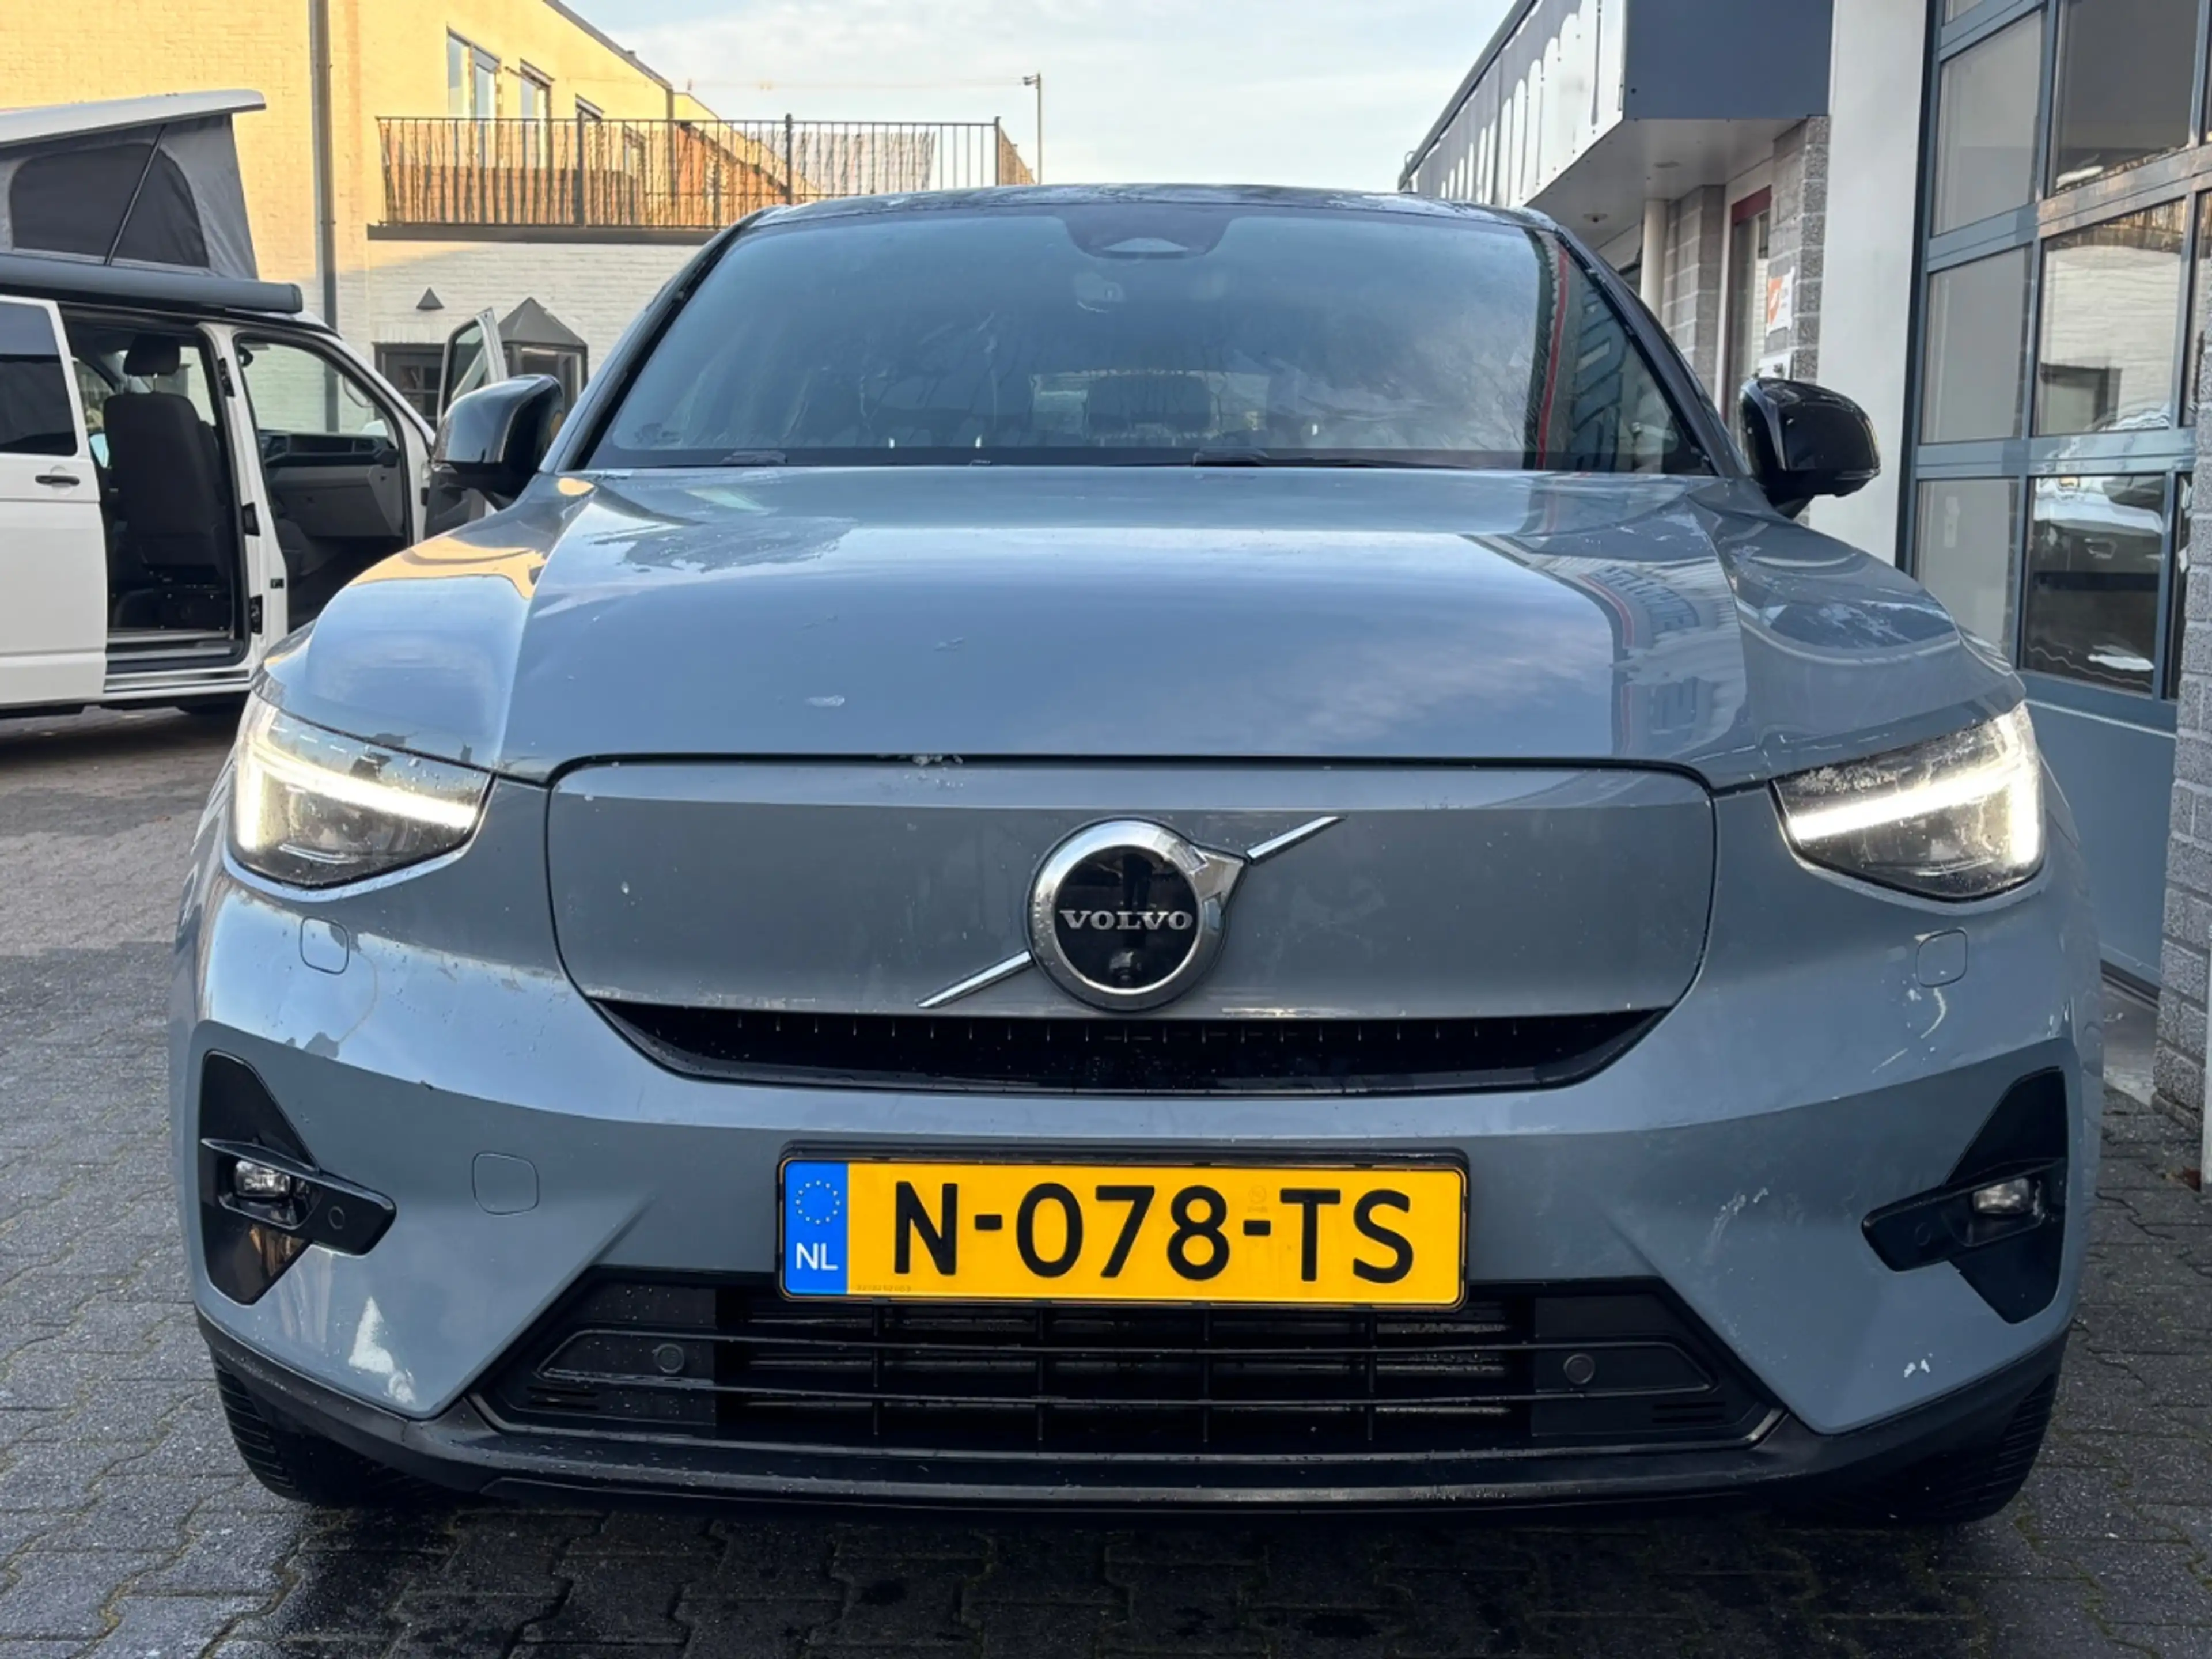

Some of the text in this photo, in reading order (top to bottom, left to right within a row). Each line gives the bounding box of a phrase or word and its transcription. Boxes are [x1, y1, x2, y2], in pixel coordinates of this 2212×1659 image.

[1059, 910, 1194, 930] VOLVO
[893, 1181, 1414, 1283] N-078-TS
[796, 1242, 839, 1271] NL
